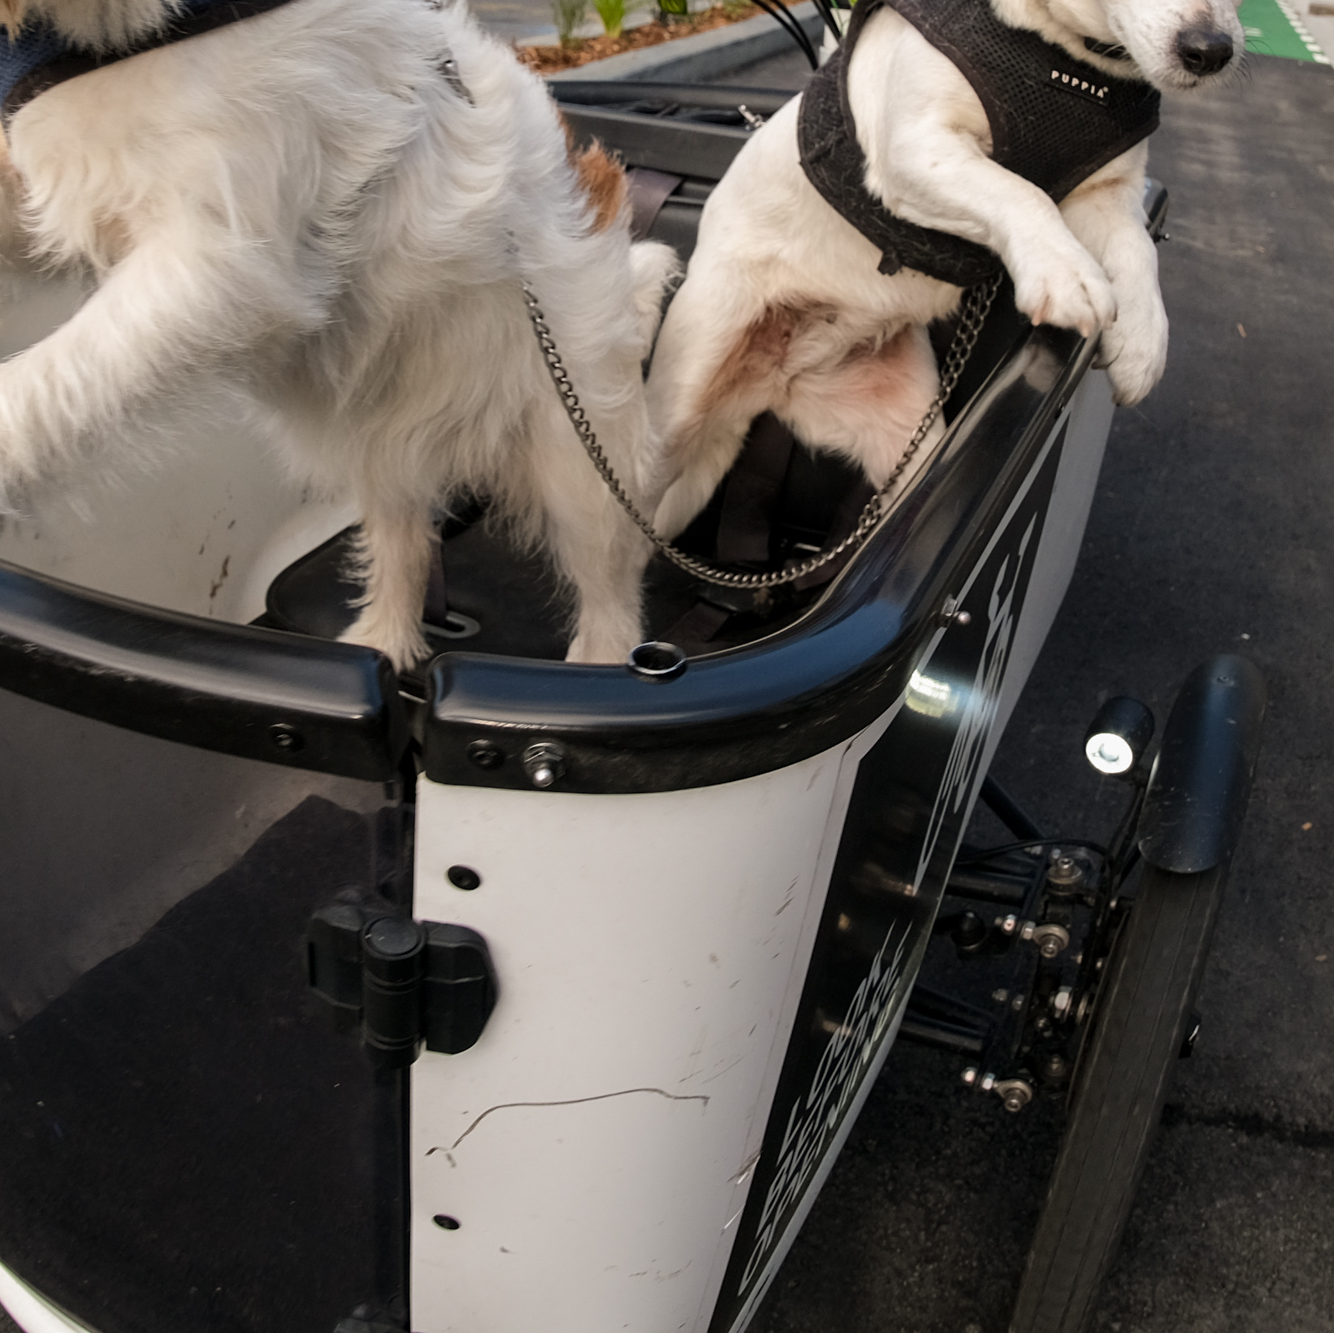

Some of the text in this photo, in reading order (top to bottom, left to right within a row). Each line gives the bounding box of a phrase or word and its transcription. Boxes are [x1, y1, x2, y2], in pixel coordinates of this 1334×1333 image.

[1051, 70, 1104, 98] PUPPIA
[755, 919, 912, 1240] BEFORE
[776, 918, 897, 1167] LOOK
